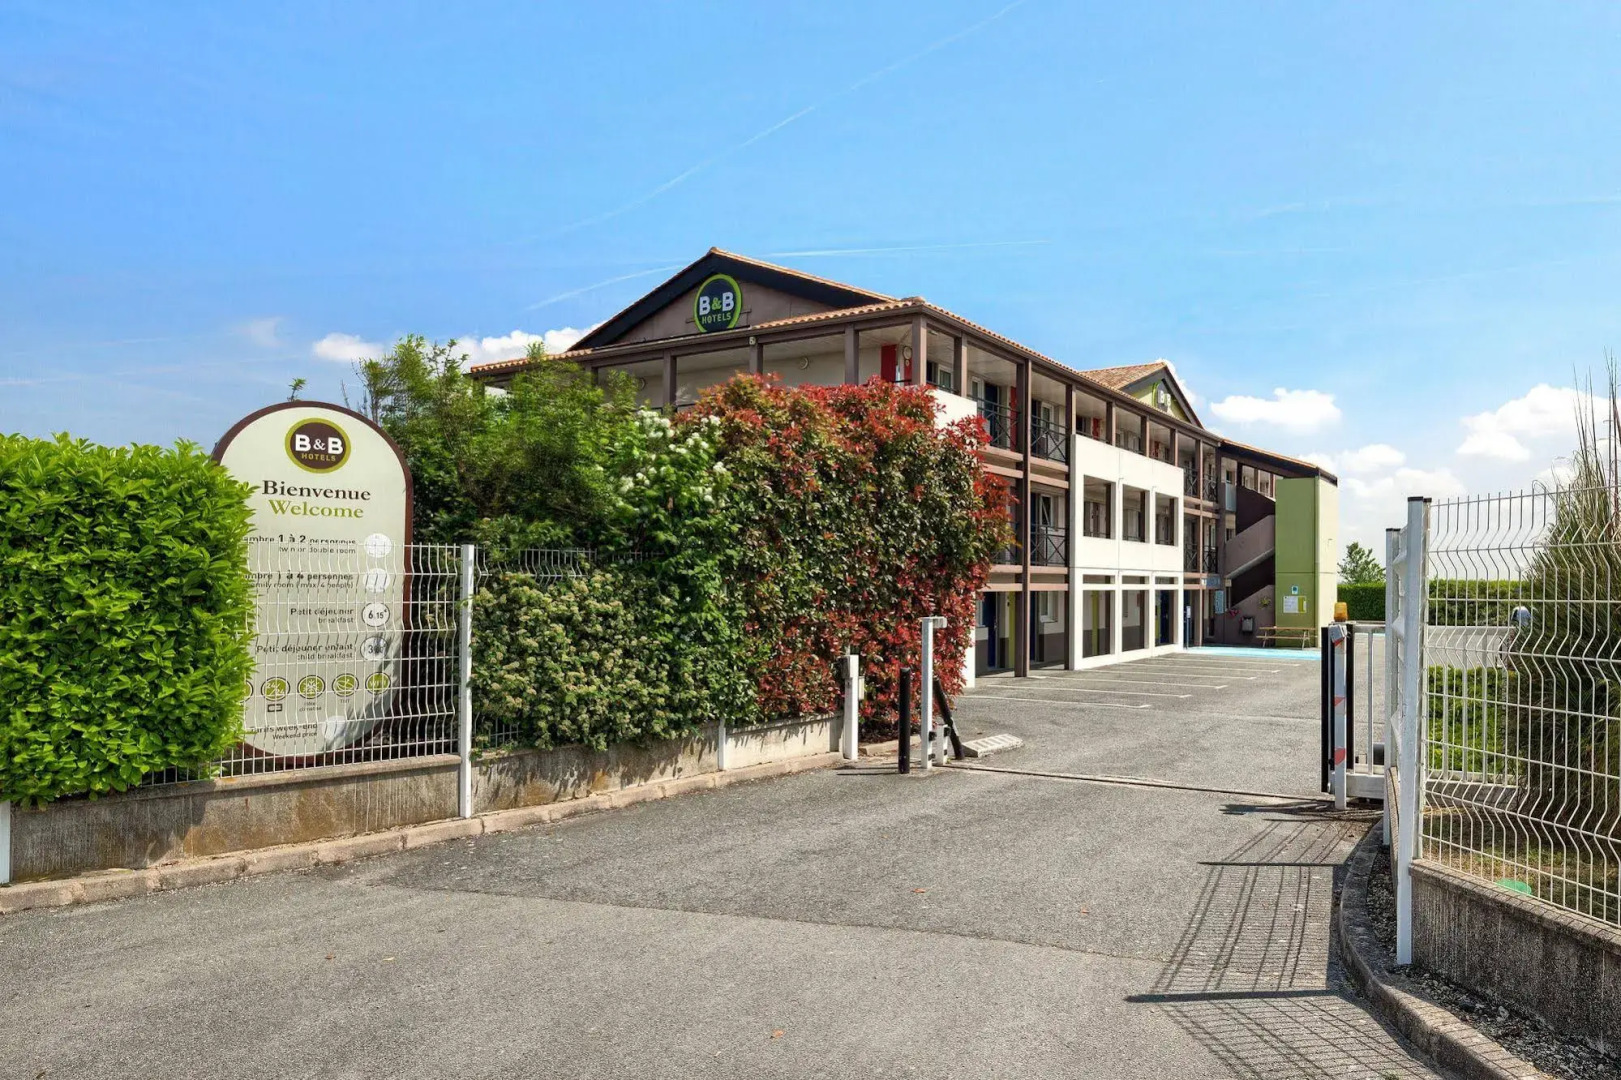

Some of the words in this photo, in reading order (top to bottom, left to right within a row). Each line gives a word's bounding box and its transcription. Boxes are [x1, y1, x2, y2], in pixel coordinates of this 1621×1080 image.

[699, 291, 735, 316] B&B
[701, 312, 732, 325] HOTELS
[295, 434, 344, 455] B&B
[301, 452, 336, 462] HOTELS
[261, 479, 371, 501] Bienvenue
[268, 499, 364, 518] Welcome
[243, 535, 275, 544] ambre
[279, 535, 284, 543] 1
[299, 535, 306, 543] 2
[309, 546, 335, 554] doube
[244, 572, 273, 580] ambre
[307, 573, 354, 582] personnes
